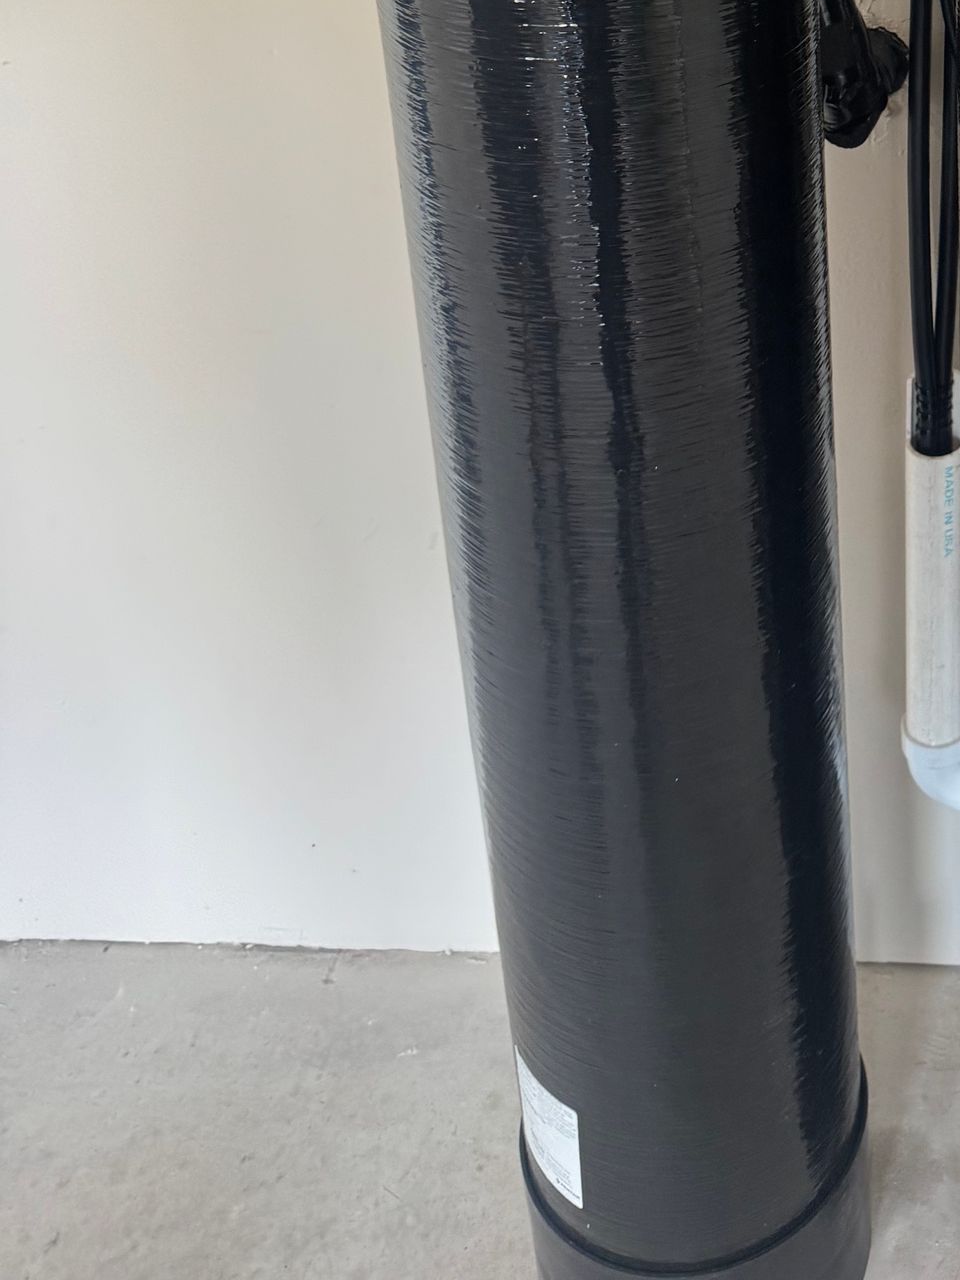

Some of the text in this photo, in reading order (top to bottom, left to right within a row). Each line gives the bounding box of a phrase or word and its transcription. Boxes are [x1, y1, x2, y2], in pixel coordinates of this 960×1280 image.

[944, 465, 954, 558] MADE IN USA
